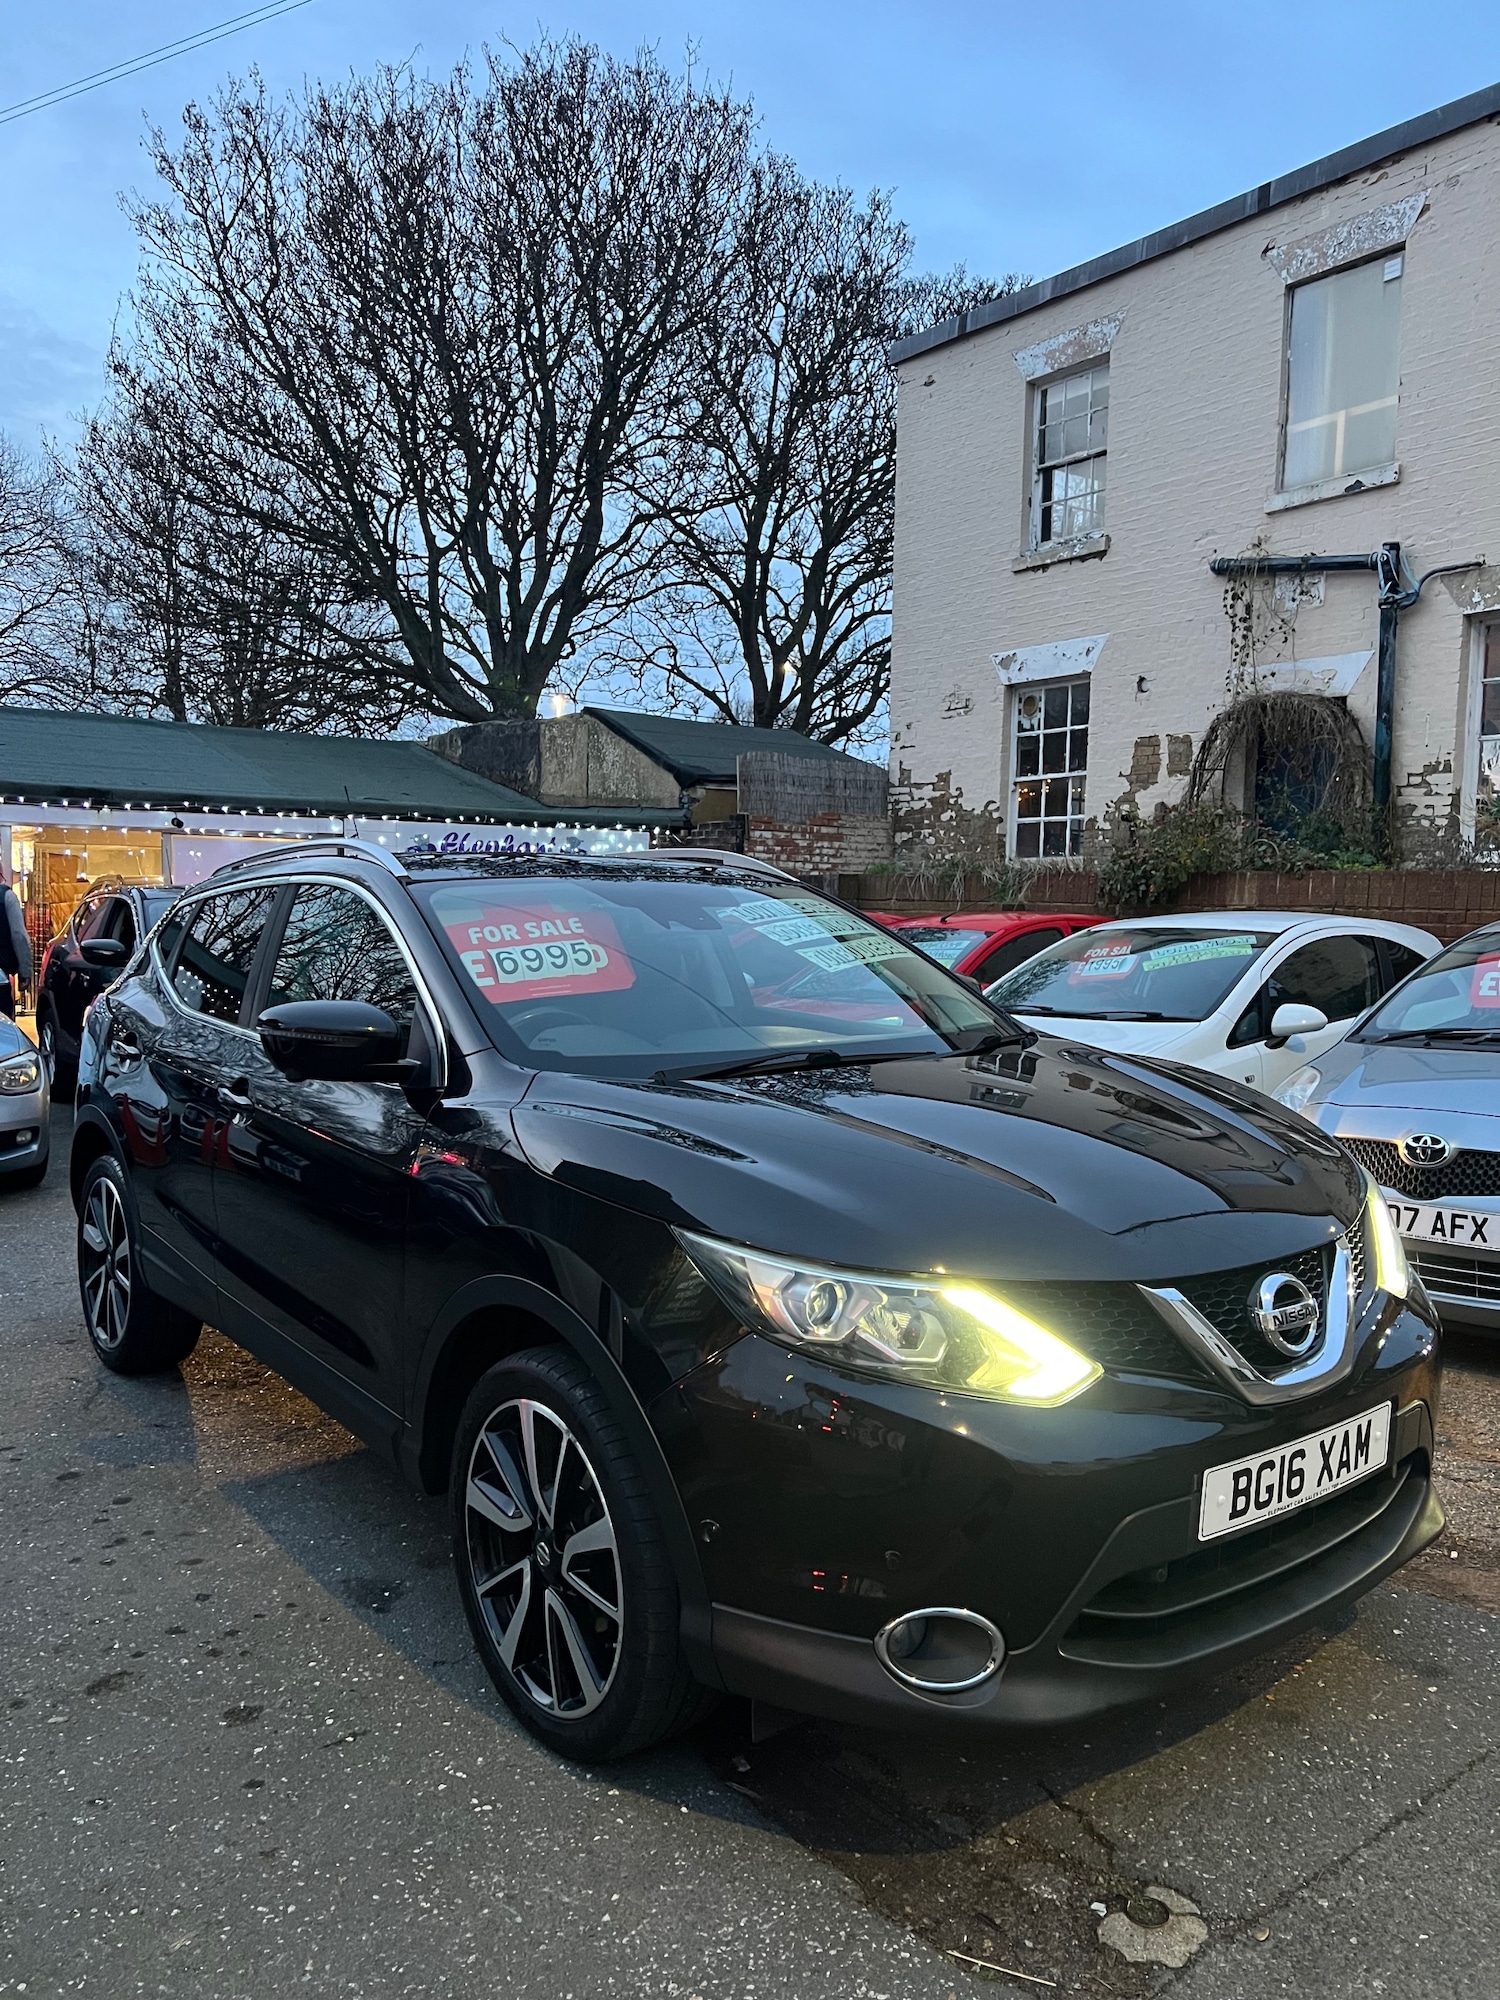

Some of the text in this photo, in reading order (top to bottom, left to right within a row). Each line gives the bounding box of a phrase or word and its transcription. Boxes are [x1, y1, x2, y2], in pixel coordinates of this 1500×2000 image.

[468, 917, 585, 944] FOR SALE
[1084, 945, 1132, 958] FOR SAL
[1430, 1210, 1489, 1243] AFX
[1228, 1418, 1373, 1521] BG16 XAM
